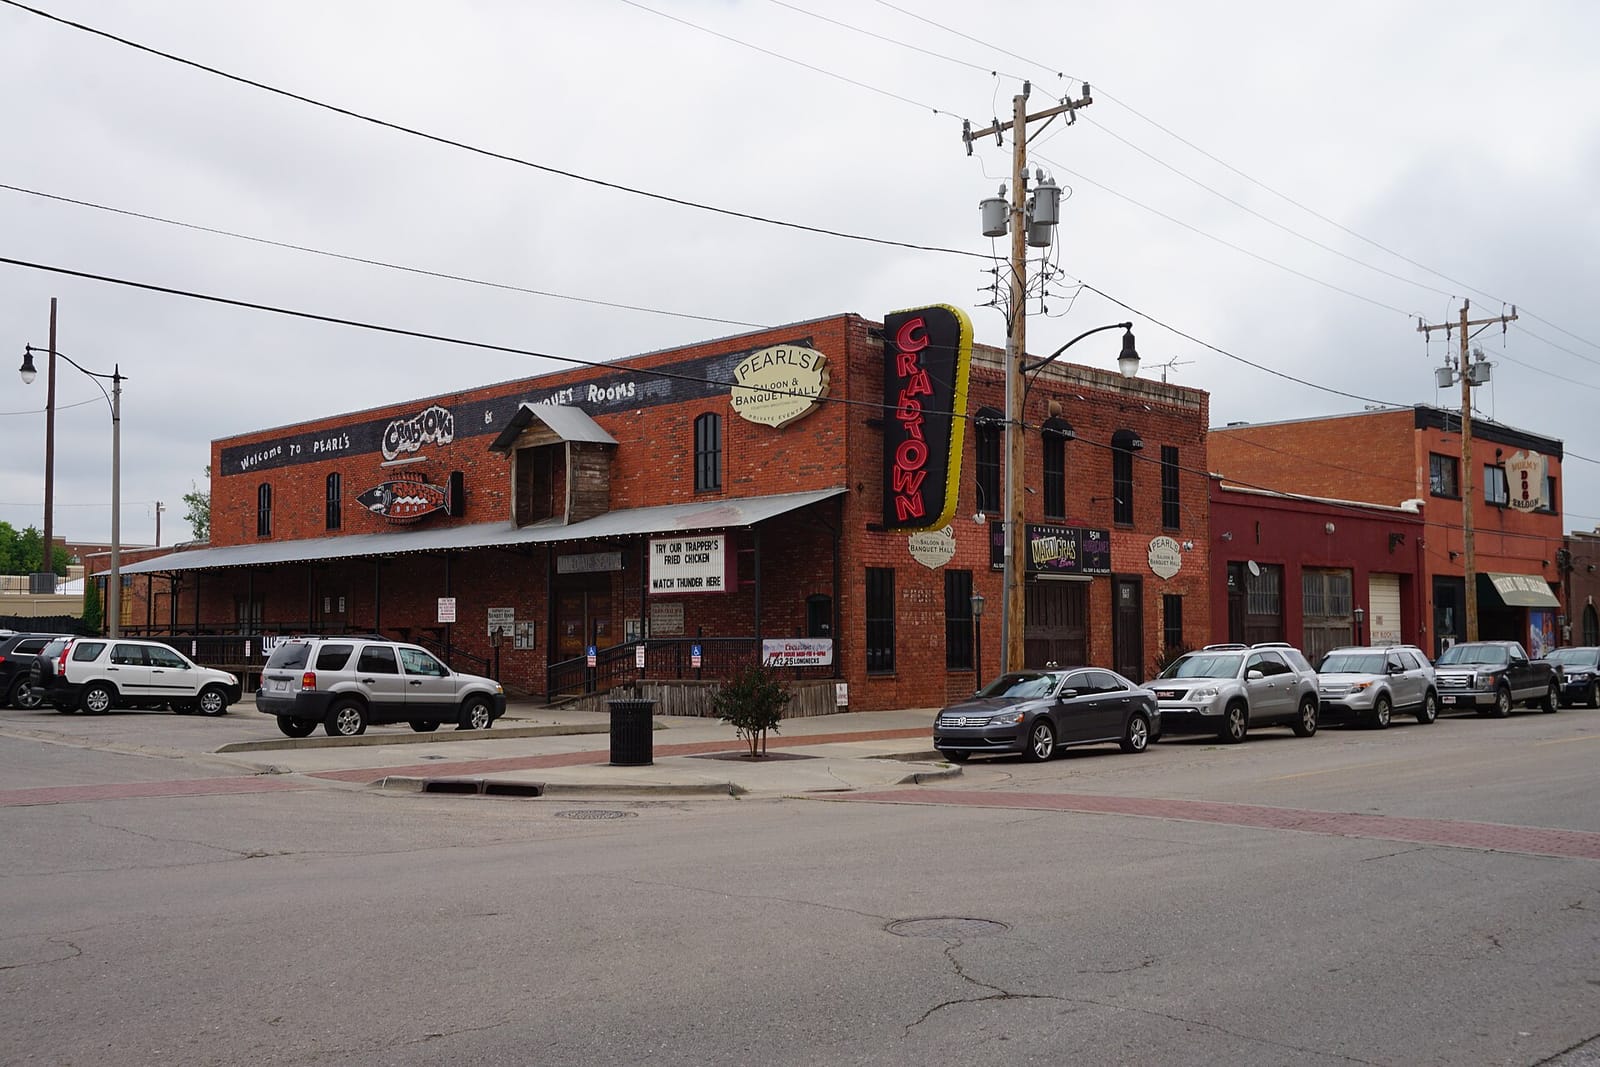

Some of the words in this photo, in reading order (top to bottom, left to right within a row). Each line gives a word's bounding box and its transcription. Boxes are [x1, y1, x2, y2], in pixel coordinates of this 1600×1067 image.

[739, 349, 812, 380] PEARL'S
[791, 377, 799, 386] &
[735, 391, 784, 406] BANQUET
[788, 385, 818, 398] HALL
[1520, 470, 1530, 501] DOG
[655, 543, 667, 554] TRY
[669, 542, 682, 553] OUR
[685, 540, 719, 552] TRAPPER'S
[664, 554, 681, 565] FRIED
[684, 552, 710, 564] CHICKEN
[653, 577, 674, 589] WATCH
[677, 577, 703, 588] THUNDER
[706, 576, 721, 587] HERE
